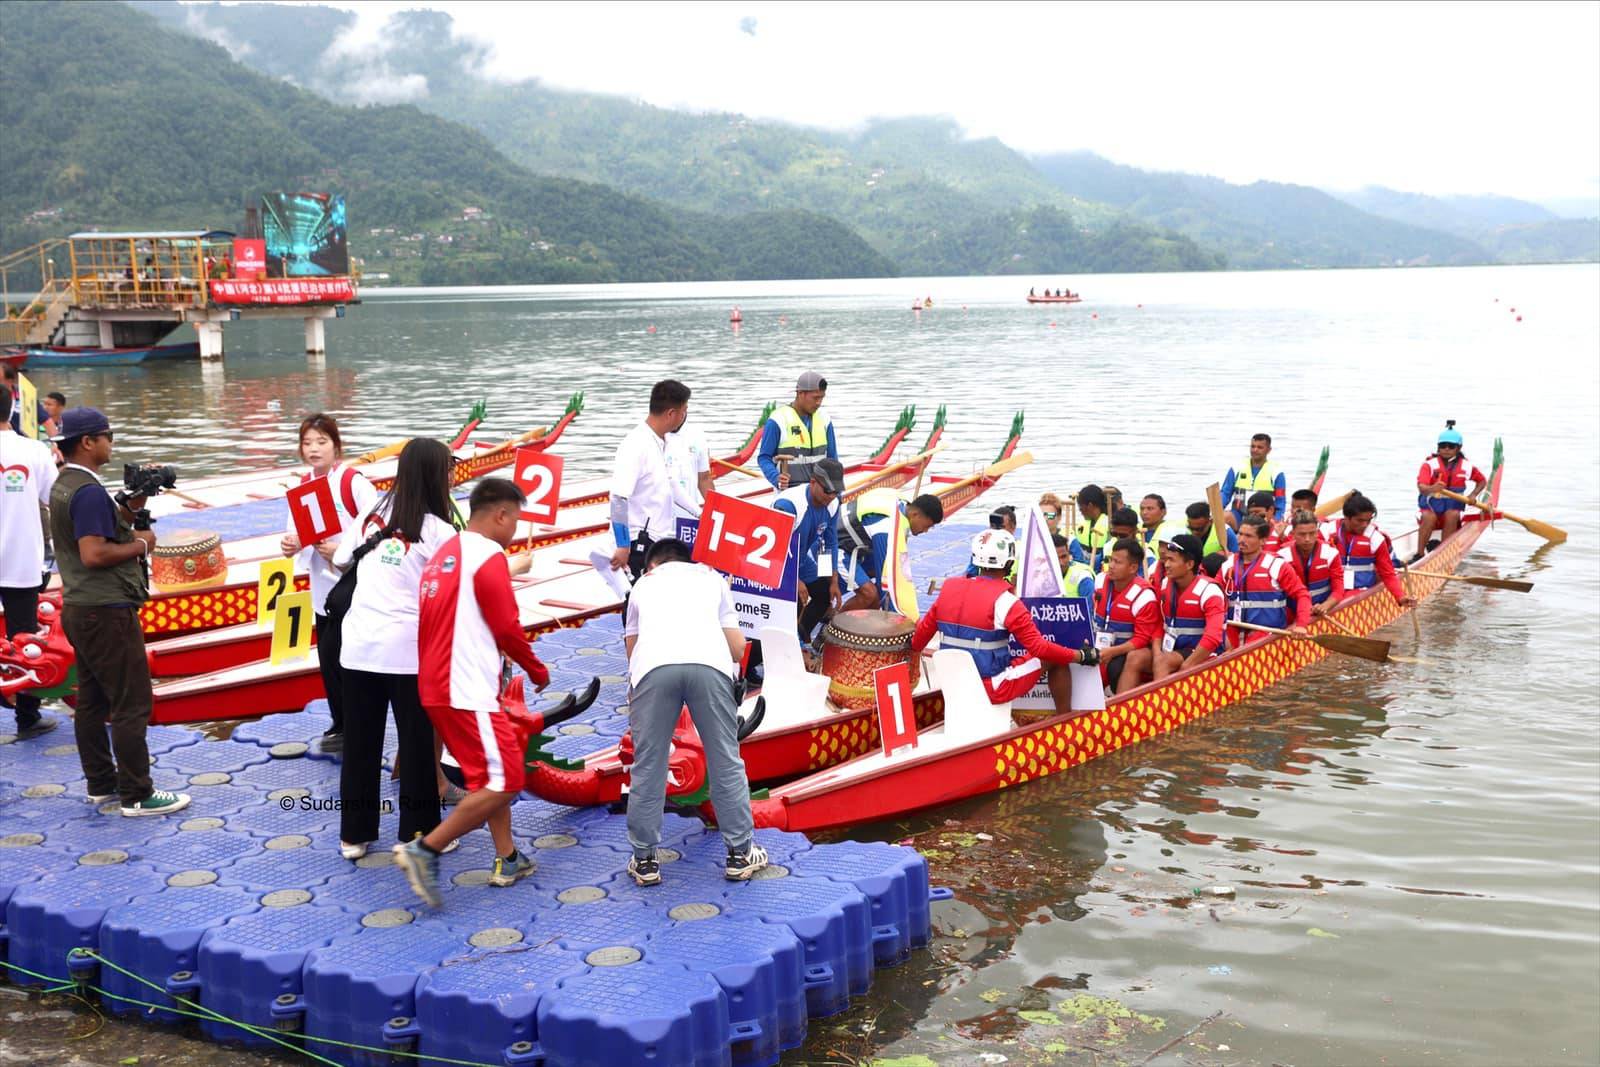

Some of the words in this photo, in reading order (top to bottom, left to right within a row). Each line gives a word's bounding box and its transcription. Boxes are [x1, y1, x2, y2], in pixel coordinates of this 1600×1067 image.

[300, 491, 327, 535] 1
[520, 464, 554, 516] 2
[708, 510, 776, 569] 1-2
[266, 571, 287, 612] 2
[288, 606, 302, 648] 1
[887, 682, 905, 736] 1
